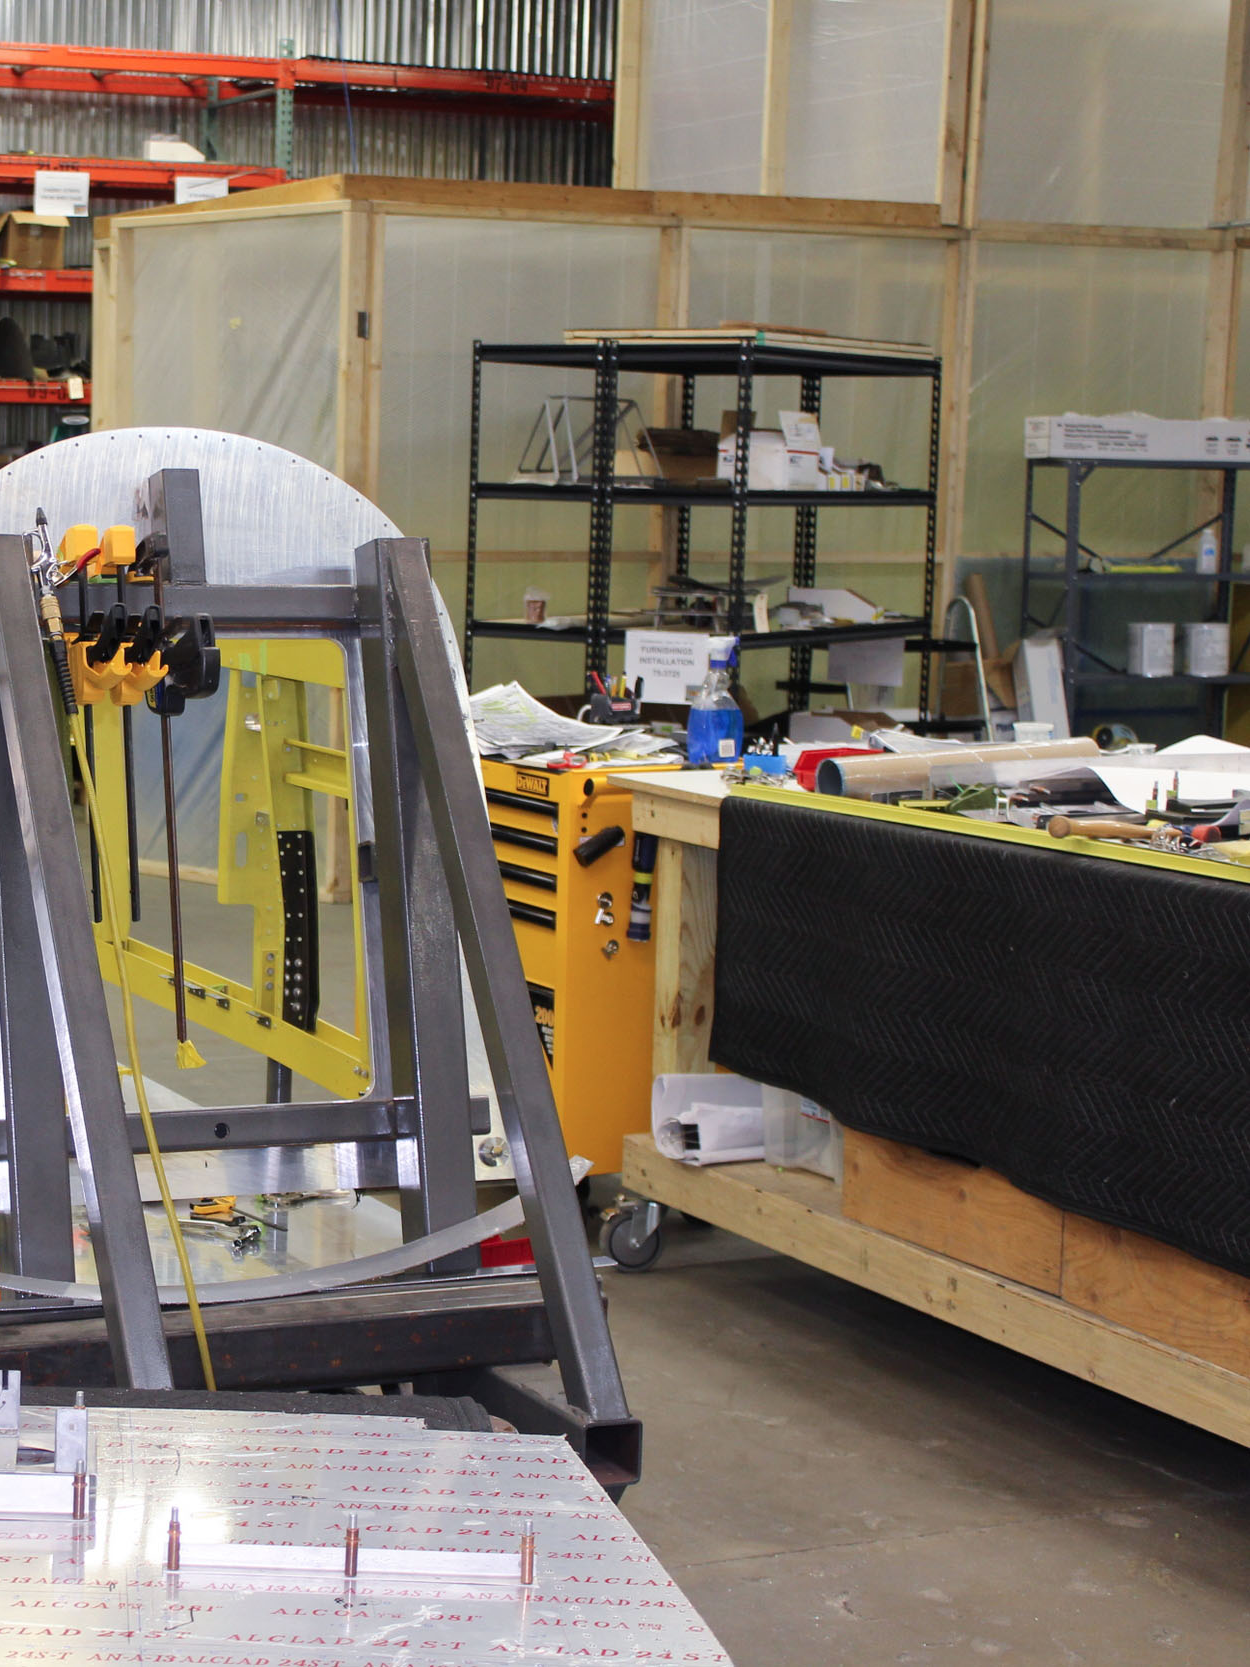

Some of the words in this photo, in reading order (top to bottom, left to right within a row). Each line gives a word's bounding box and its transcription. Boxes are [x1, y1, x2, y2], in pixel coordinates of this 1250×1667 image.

[641, 646, 694, 656] FURNISHINGS
[639, 656, 695, 666] INSTALLATION
[11, 1600, 108, 1608] ALCOA
[270, 1608, 370, 1617] ALCOA
[532, 1618, 630, 1628] ALCOA
